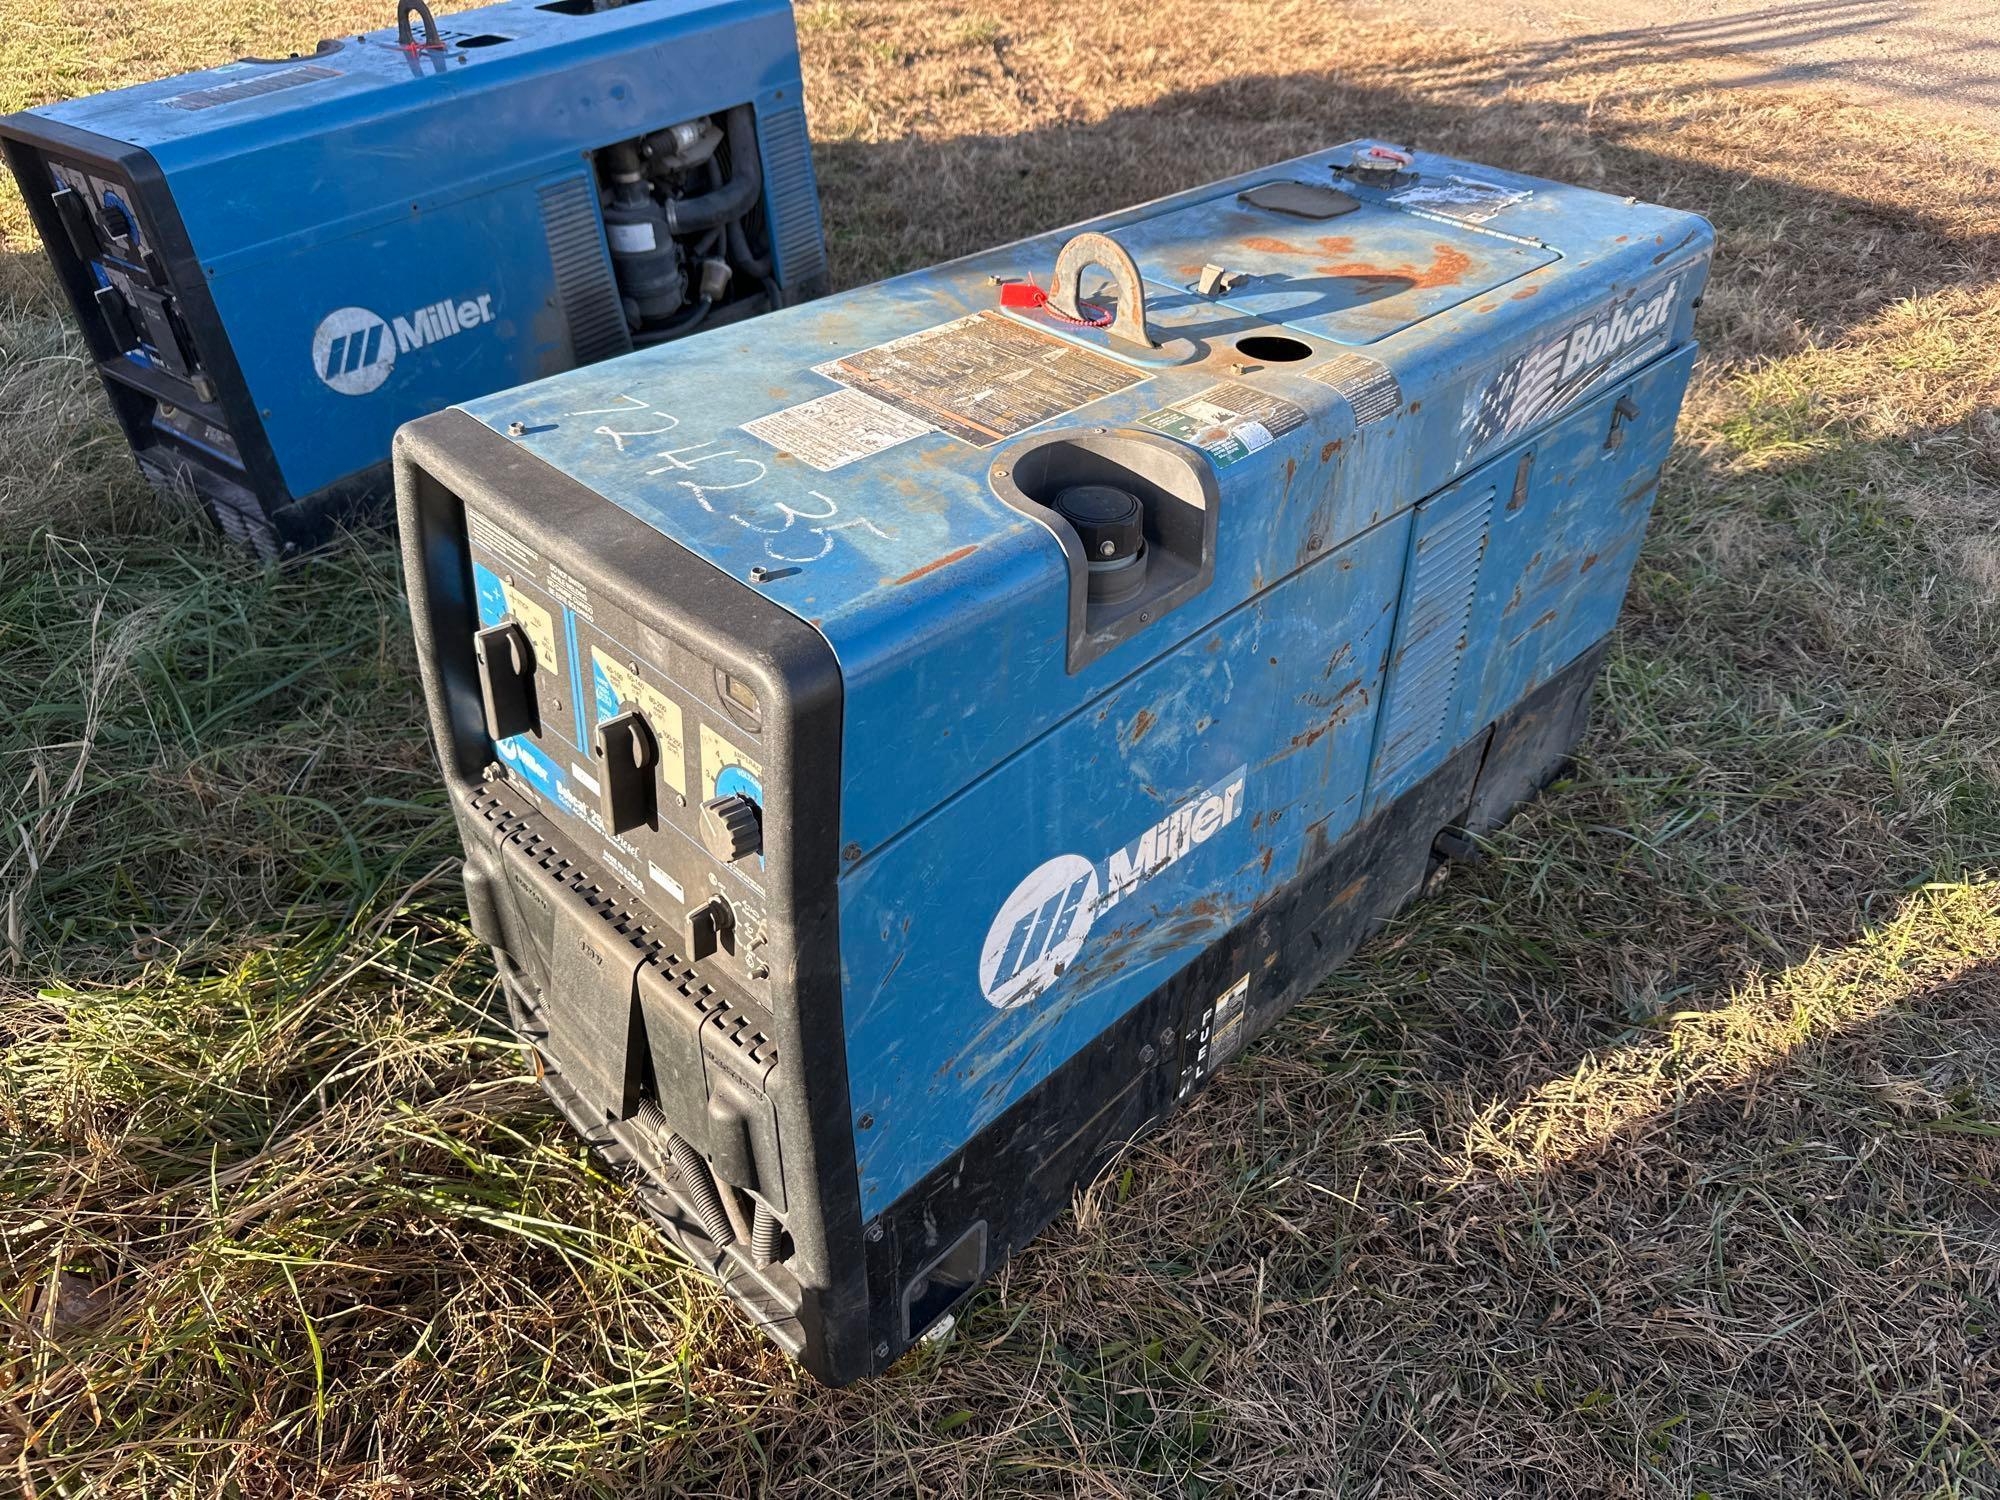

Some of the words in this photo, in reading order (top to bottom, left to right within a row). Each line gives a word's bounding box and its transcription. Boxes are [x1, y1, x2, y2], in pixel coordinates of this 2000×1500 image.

[392, 293, 492, 354] Miller
[1561, 281, 1677, 380] Bobcat
[564, 394, 899, 563] 724235
[1108, 778, 1243, 905] Miller
[1195, 1007, 1213, 1080] FUEL
